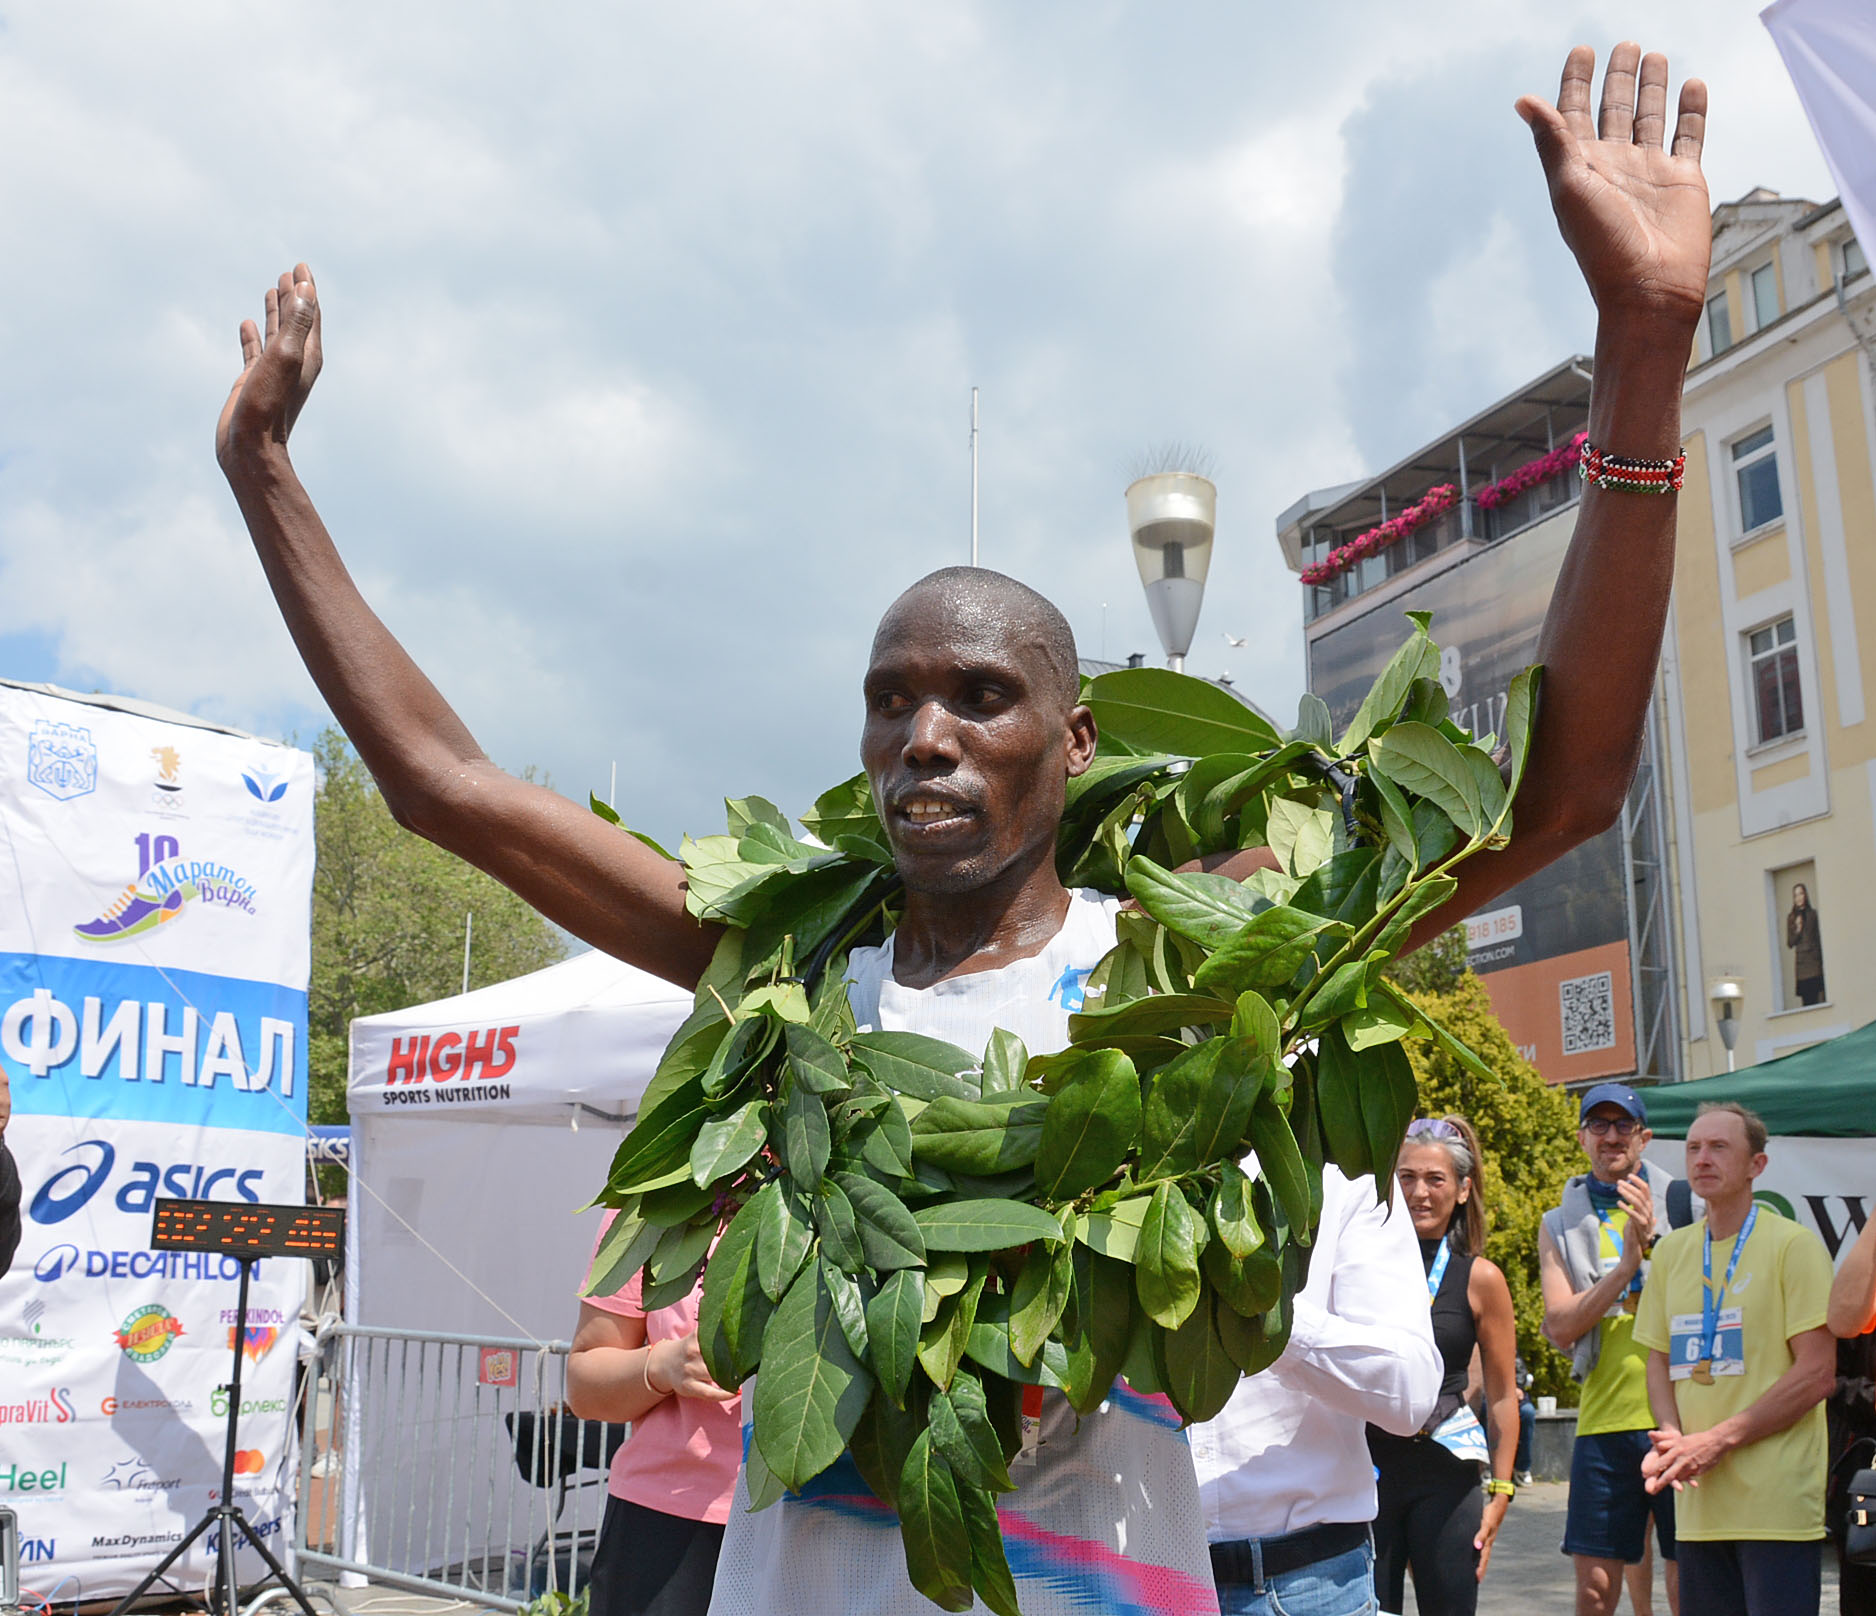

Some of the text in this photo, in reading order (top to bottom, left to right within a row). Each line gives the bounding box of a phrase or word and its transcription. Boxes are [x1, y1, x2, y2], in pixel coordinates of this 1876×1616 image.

[134, 832, 179, 880] 10
[146, 860, 257, 900] Маратон
[197, 878, 257, 916] Варна
[1465, 944, 1516, 966] ECTION.COM
[1, 987, 295, 1097] ФИНАЛ
[384, 1025, 521, 1087] HIGH5
[382, 1083, 510, 1106] SPORTS NUTRITION
[85, 1250, 261, 1282] DECATHLON
[1685, 1333, 1723, 1362] 64
